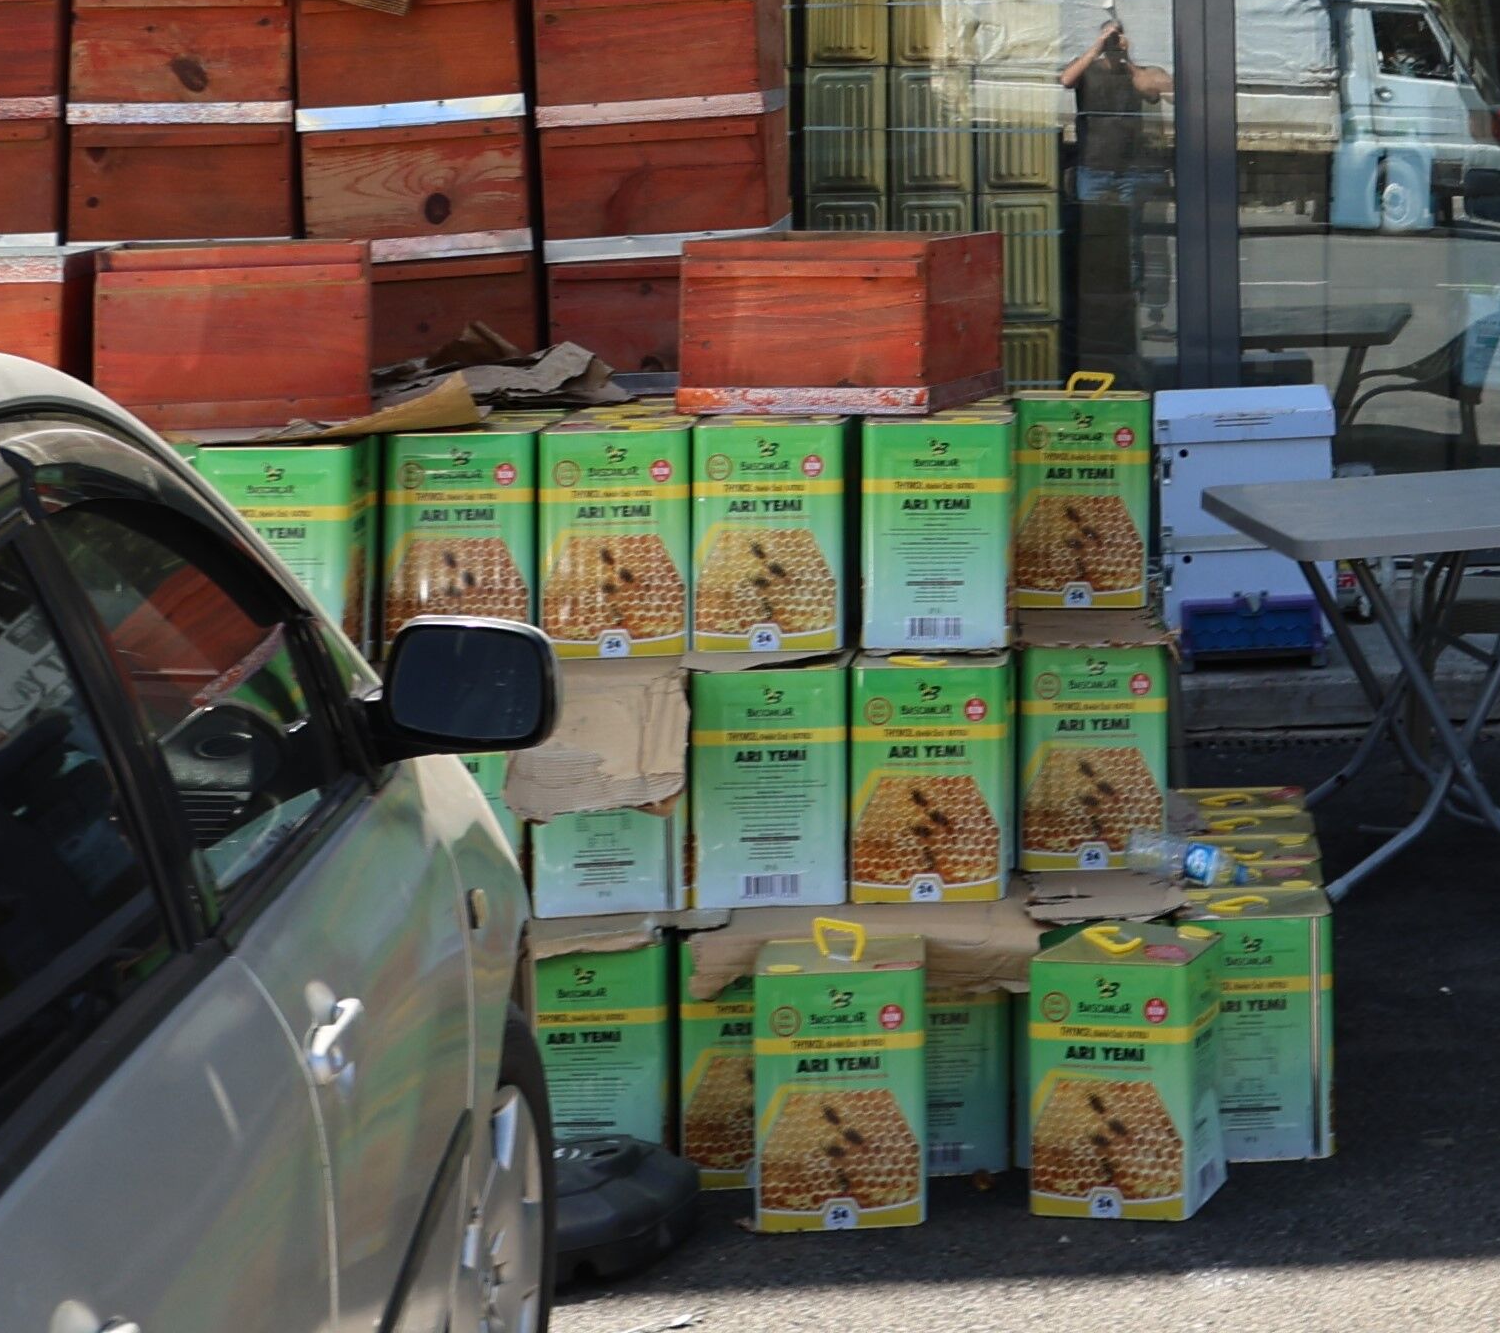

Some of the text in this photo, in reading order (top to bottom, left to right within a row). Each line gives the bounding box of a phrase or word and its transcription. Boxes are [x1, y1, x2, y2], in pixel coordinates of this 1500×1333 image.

[1046, 464, 1115, 480] ARI YEMİ
[576, 501, 652, 519] ARI YEMİ
[728, 495, 804, 513] ARI YEMİ
[902, 495, 972, 512] ARI YEMİ
[419, 505, 495, 522] ARI YEMİ
[267, 524, 306, 539] YEMİ
[1056, 713, 1131, 732] ARI YEMİ
[734, 746, 807, 764] ARI YEMİ
[887, 740, 965, 759] ARI YEMİ
[1247, 995, 1287, 1011] YEMİ
[546, 1028, 621, 1045] ARI YEMİ
[720, 1022, 753, 1037] ARI
[1065, 1044, 1145, 1062] ARI YEMİ
[796, 1052, 880, 1073] ARI YEMİ
